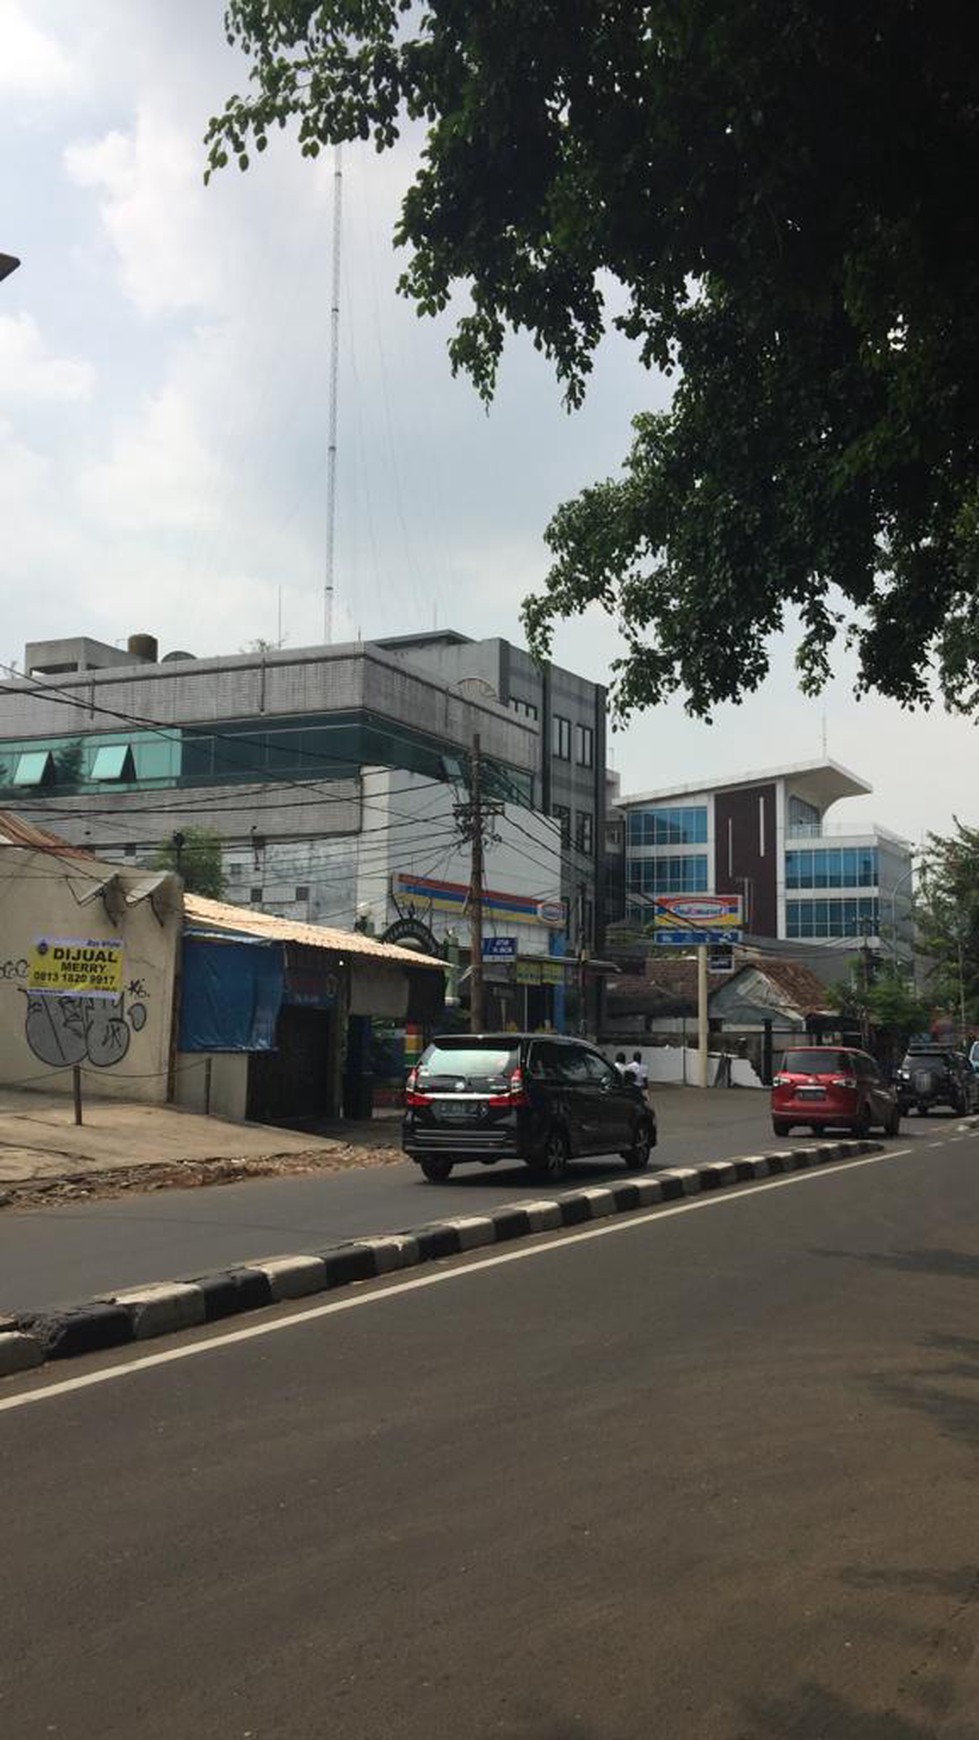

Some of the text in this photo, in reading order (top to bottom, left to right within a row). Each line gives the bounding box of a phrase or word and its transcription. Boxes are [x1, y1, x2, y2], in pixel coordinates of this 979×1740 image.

[53, 948, 118, 963] DIJUAL
[61, 962, 106, 973] MERRY
[33, 971, 115, 985] 0813 1820 9917
